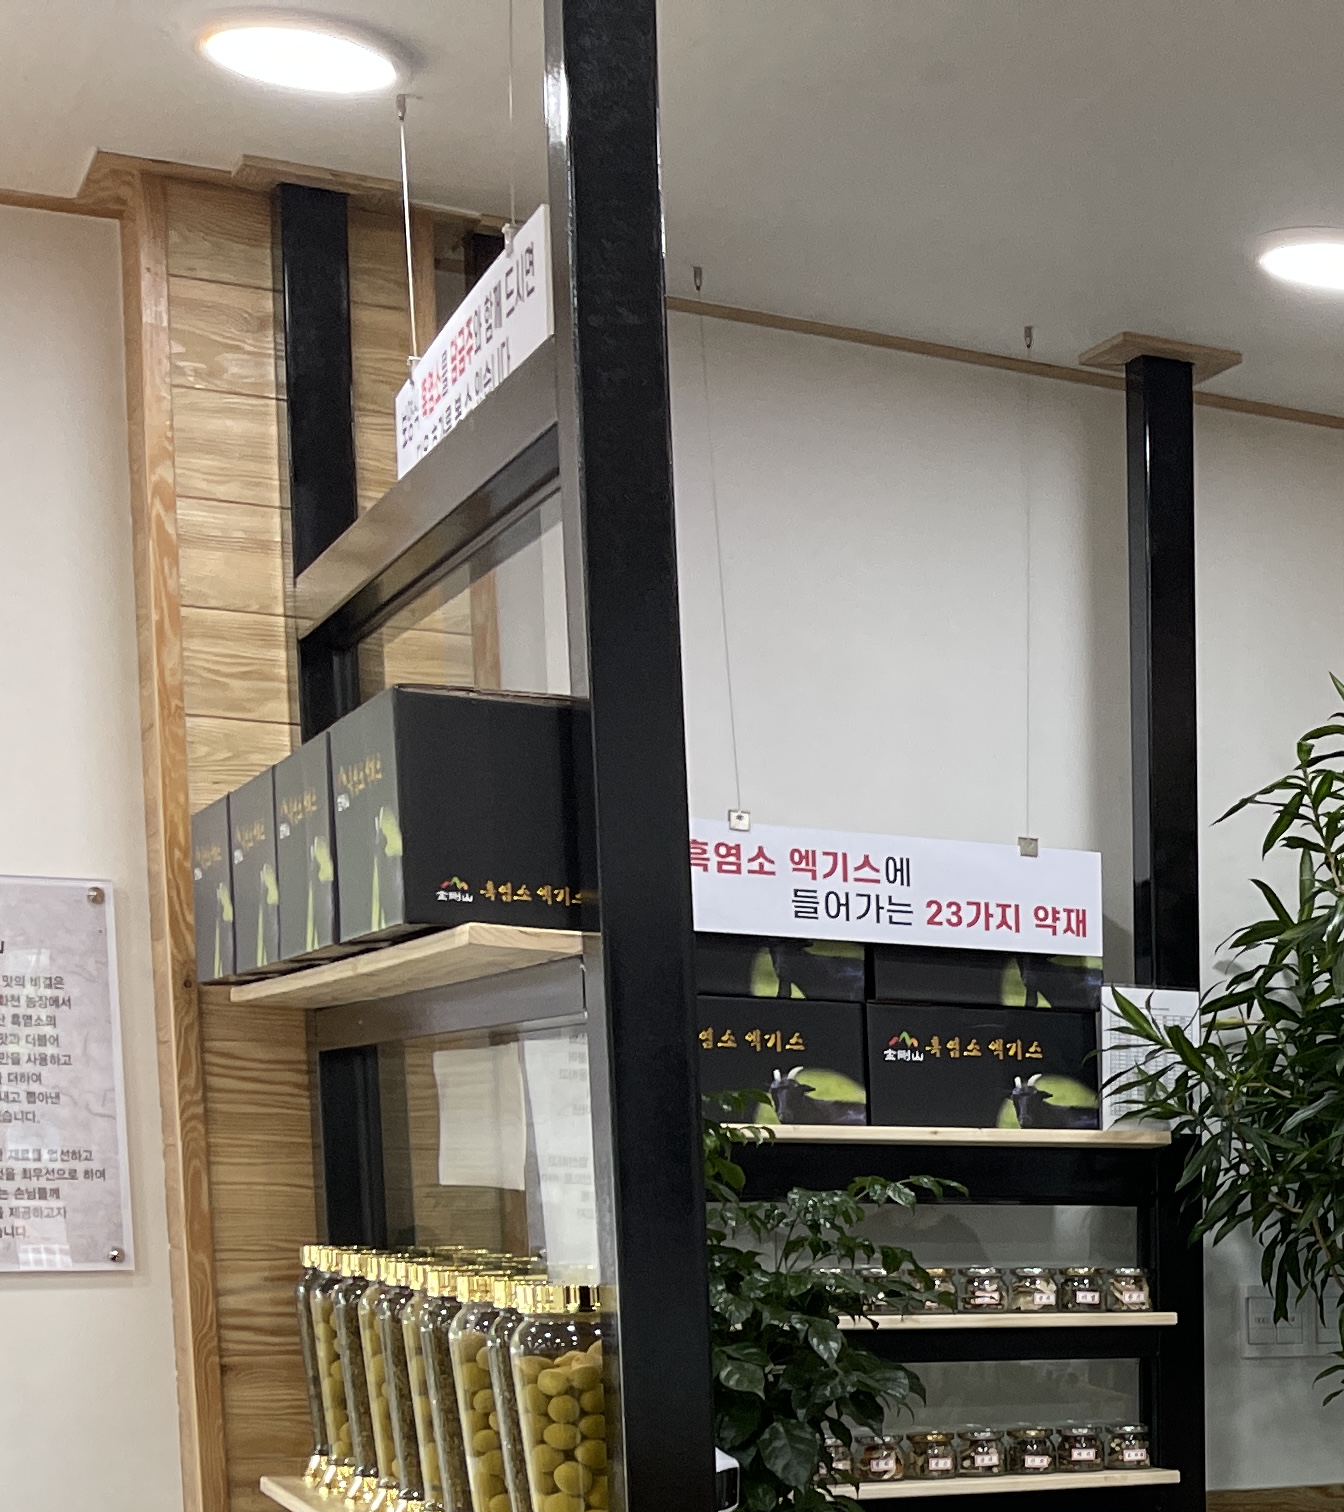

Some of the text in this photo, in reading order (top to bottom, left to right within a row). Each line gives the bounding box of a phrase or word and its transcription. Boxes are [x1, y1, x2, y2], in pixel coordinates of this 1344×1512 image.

[505, 241, 536, 320] 드시면
[690, 839, 911, 888] 흑염소 엑기스에
[479, 880, 533, 903] 흑염소
[791, 888, 1088, 938] 들어가는 23가지 약재
[29, 975, 65, 990] 비결은
[25, 995, 72, 1010] 농장에서
[11, 1013, 57, 1029] 흑염소의
[24, 1033, 60, 1048] 더불어
[744, 1028, 806, 1052] 엑기스
[925, 1034, 982, 1060] 흑염소
[987, 1037, 1044, 1061] 엑기스
[25, 1052, 73, 1067] 사용하고
[7, 1071, 42, 1085] 더하여
[83, 1168, 107, 1182] 하여
